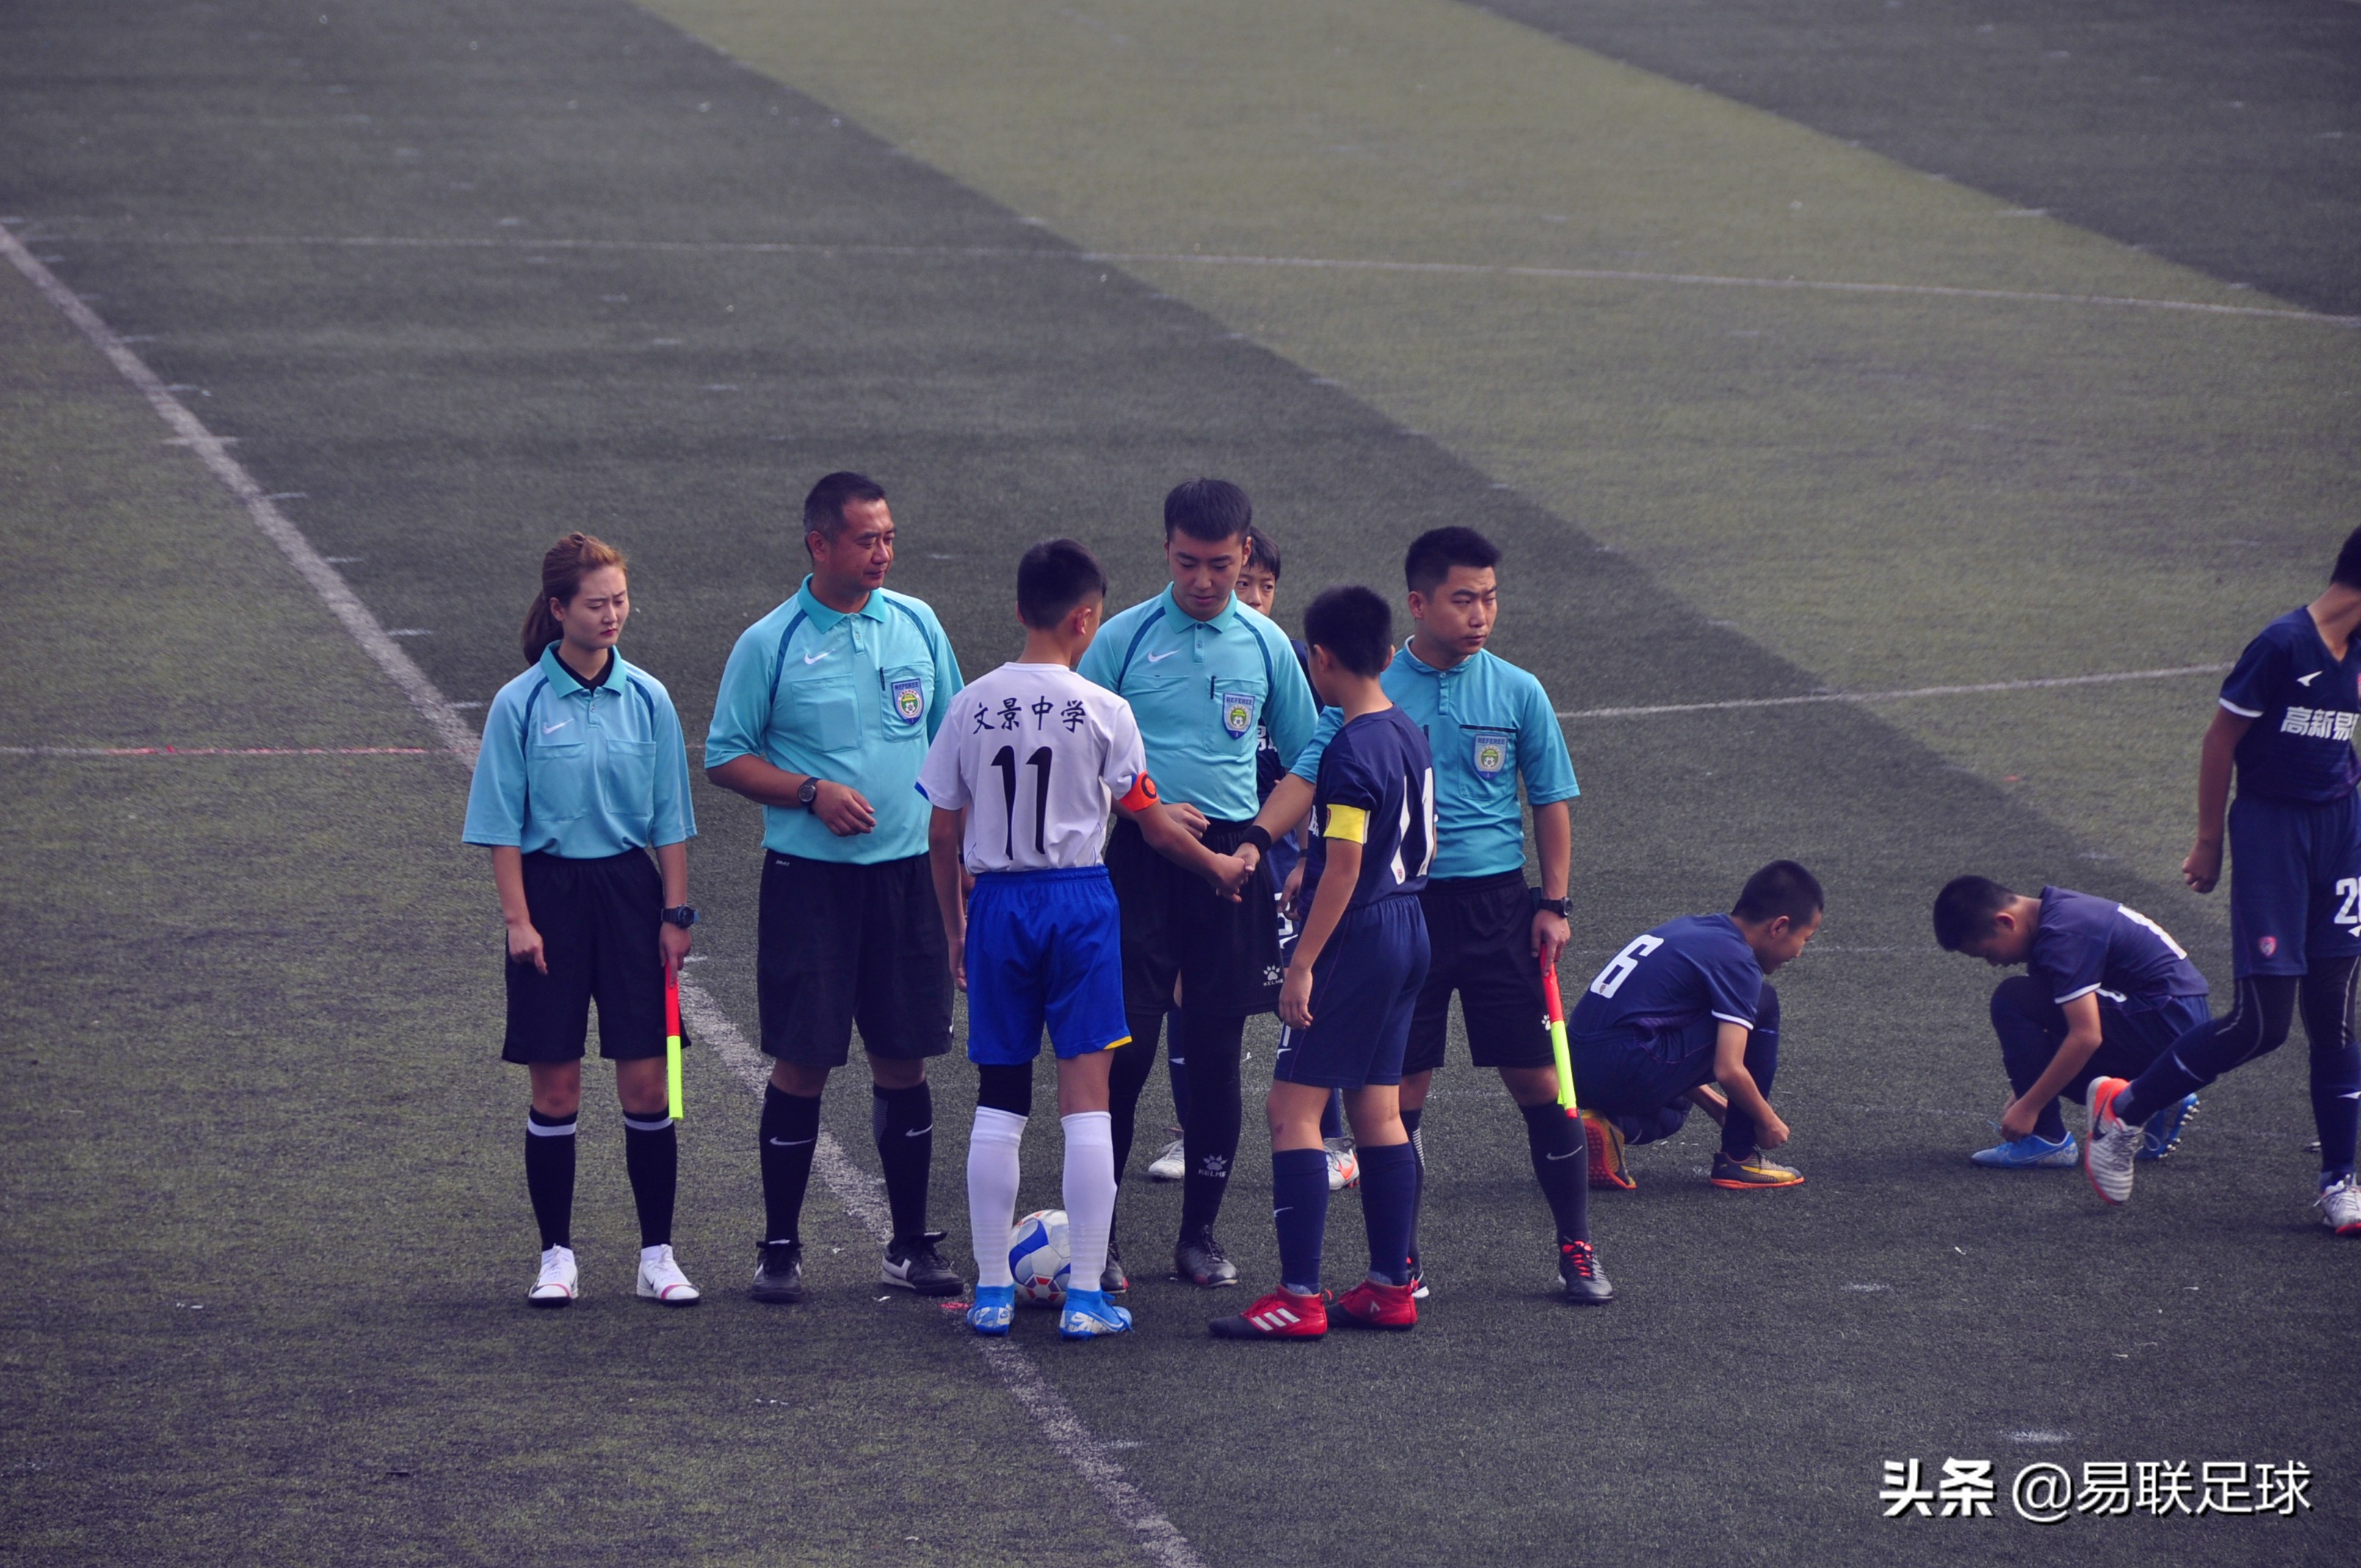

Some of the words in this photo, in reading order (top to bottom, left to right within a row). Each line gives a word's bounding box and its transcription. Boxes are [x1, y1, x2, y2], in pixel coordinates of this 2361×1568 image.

[894, 681, 919, 690] REFEREE
[1226, 696, 1252, 705] REFEREE
[972, 695, 1087, 735] 文景中学
[2280, 706, 2360, 741] 高新易
[1477, 737, 1505, 745] REFEREE
[990, 745, 1053, 860] 11
[2334, 876, 2361, 924] 2
[1590, 934, 1664, 998] 6
[1263, 978, 1284, 987] KELME
[1197, 1169, 1227, 1177] KELME
